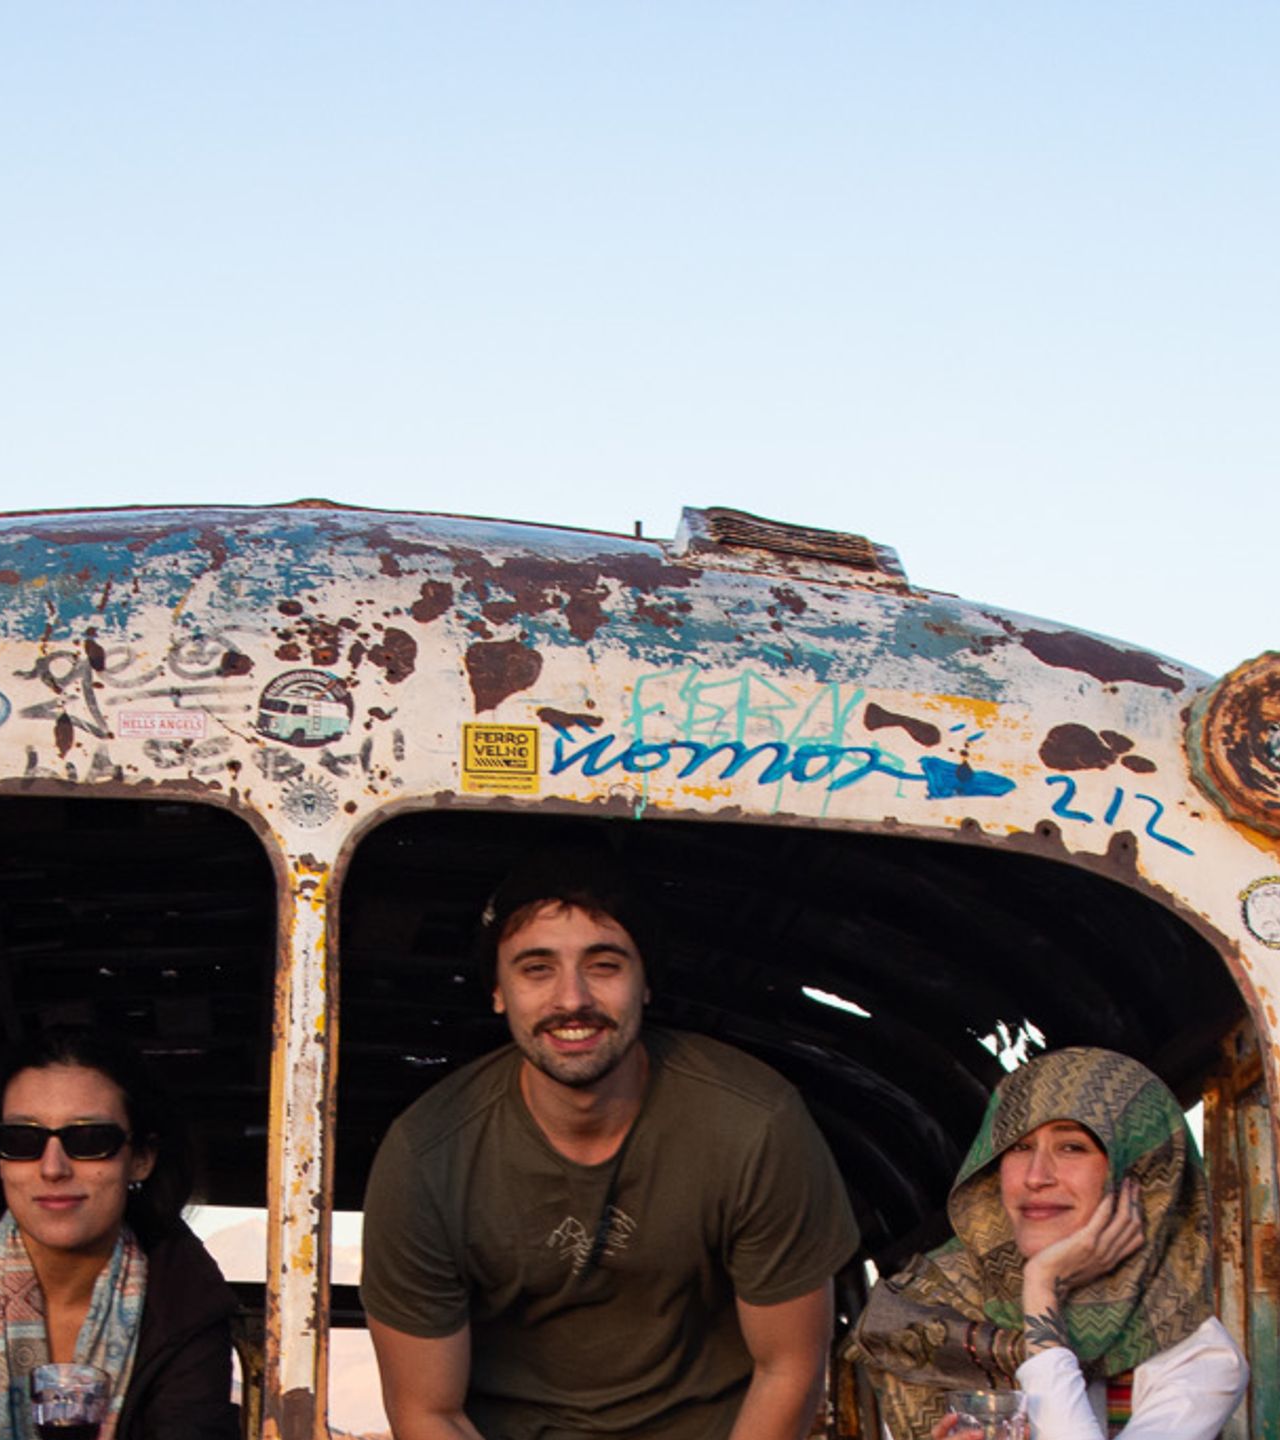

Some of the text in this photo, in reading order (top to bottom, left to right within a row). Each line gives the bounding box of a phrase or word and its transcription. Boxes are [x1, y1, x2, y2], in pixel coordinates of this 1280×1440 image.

[122, 718, 204, 731] HELLS ANGELS
[474, 731, 529, 745] FERRO
[1045, 774, 1196, 857] 212
